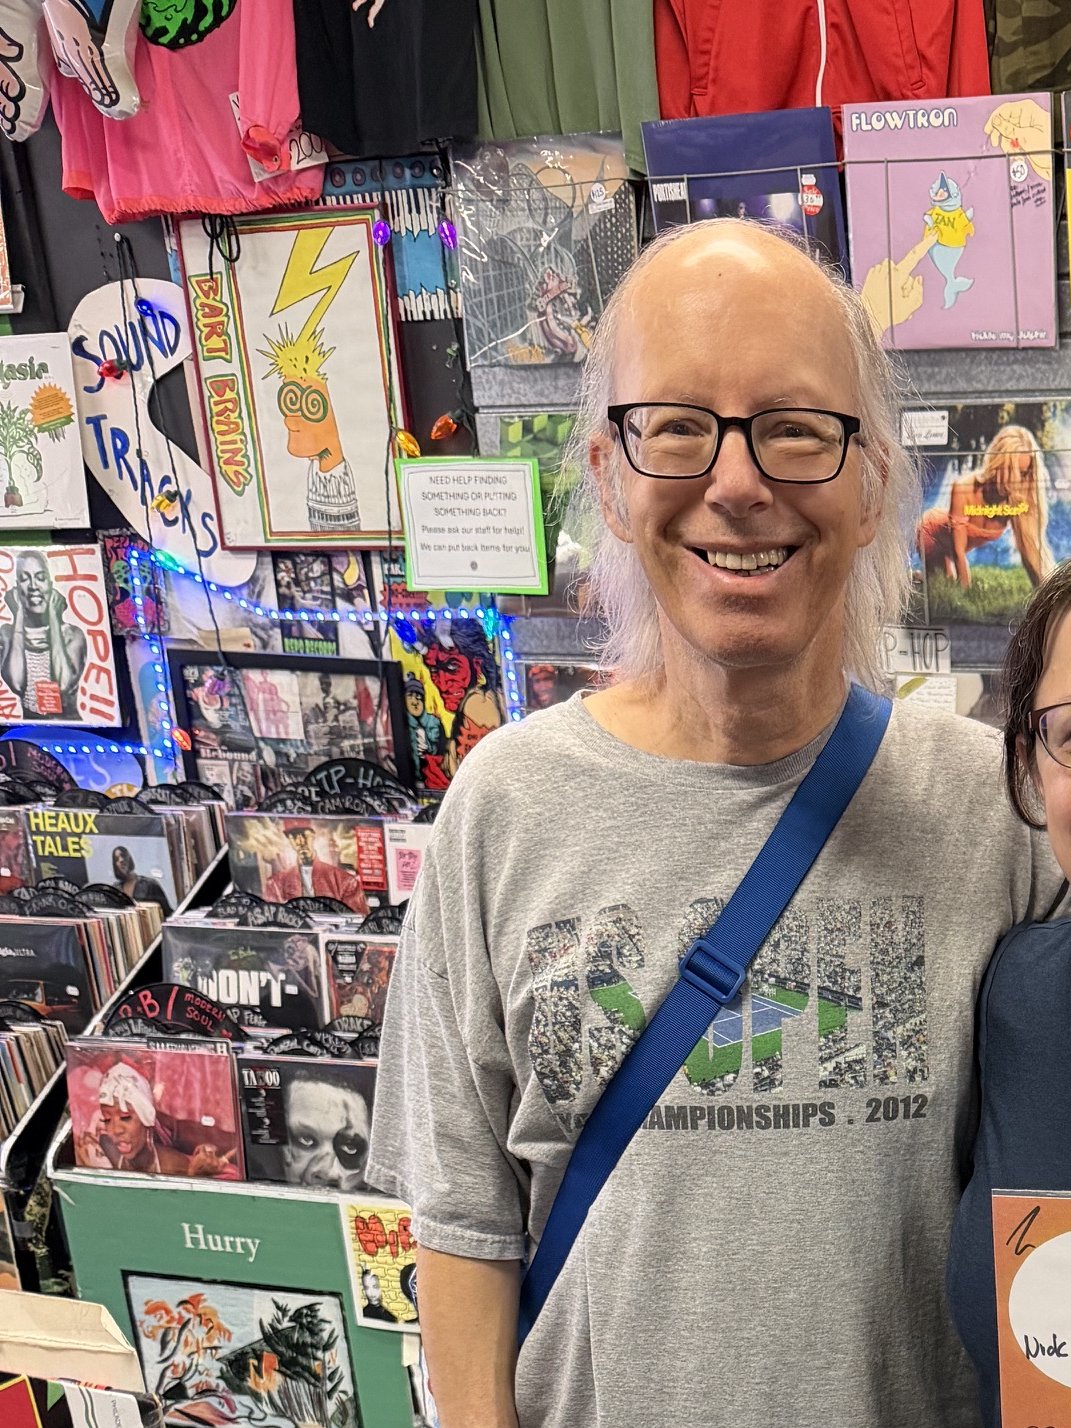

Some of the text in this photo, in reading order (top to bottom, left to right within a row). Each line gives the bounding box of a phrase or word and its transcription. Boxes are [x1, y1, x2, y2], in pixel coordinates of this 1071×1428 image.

[851, 107, 958, 132] FLOWTRON
[190, 272, 232, 362] BART
[71, 309, 182, 394] SOUND
[85, 414, 219, 558] TRACKS
[430, 475, 508, 485] NEED HELP FINDING
[421, 491, 518, 501] SOMETHING OR PUTTING
[433, 507, 508, 517] SOMETHING BACK?
[963, 504, 1002, 518] Midnight
[421, 525, 446, 534] Please
[447, 525, 460, 534] ask
[461, 527, 474, 535] our
[475, 525, 491, 535] staff
[492, 525, 504, 535] for
[420, 543, 514, 554] We can put back items for
[47, 547, 116, 723] HOPE!!
[29, 811, 100, 834] HEAUX
[31, 836, 94, 858] TALES
[185, 1006, 215, 1033] SOUL
[640, 1094, 928, 1131] AMPIONSHIPS 2012
[180, 1222, 261, 1263] Hurry
